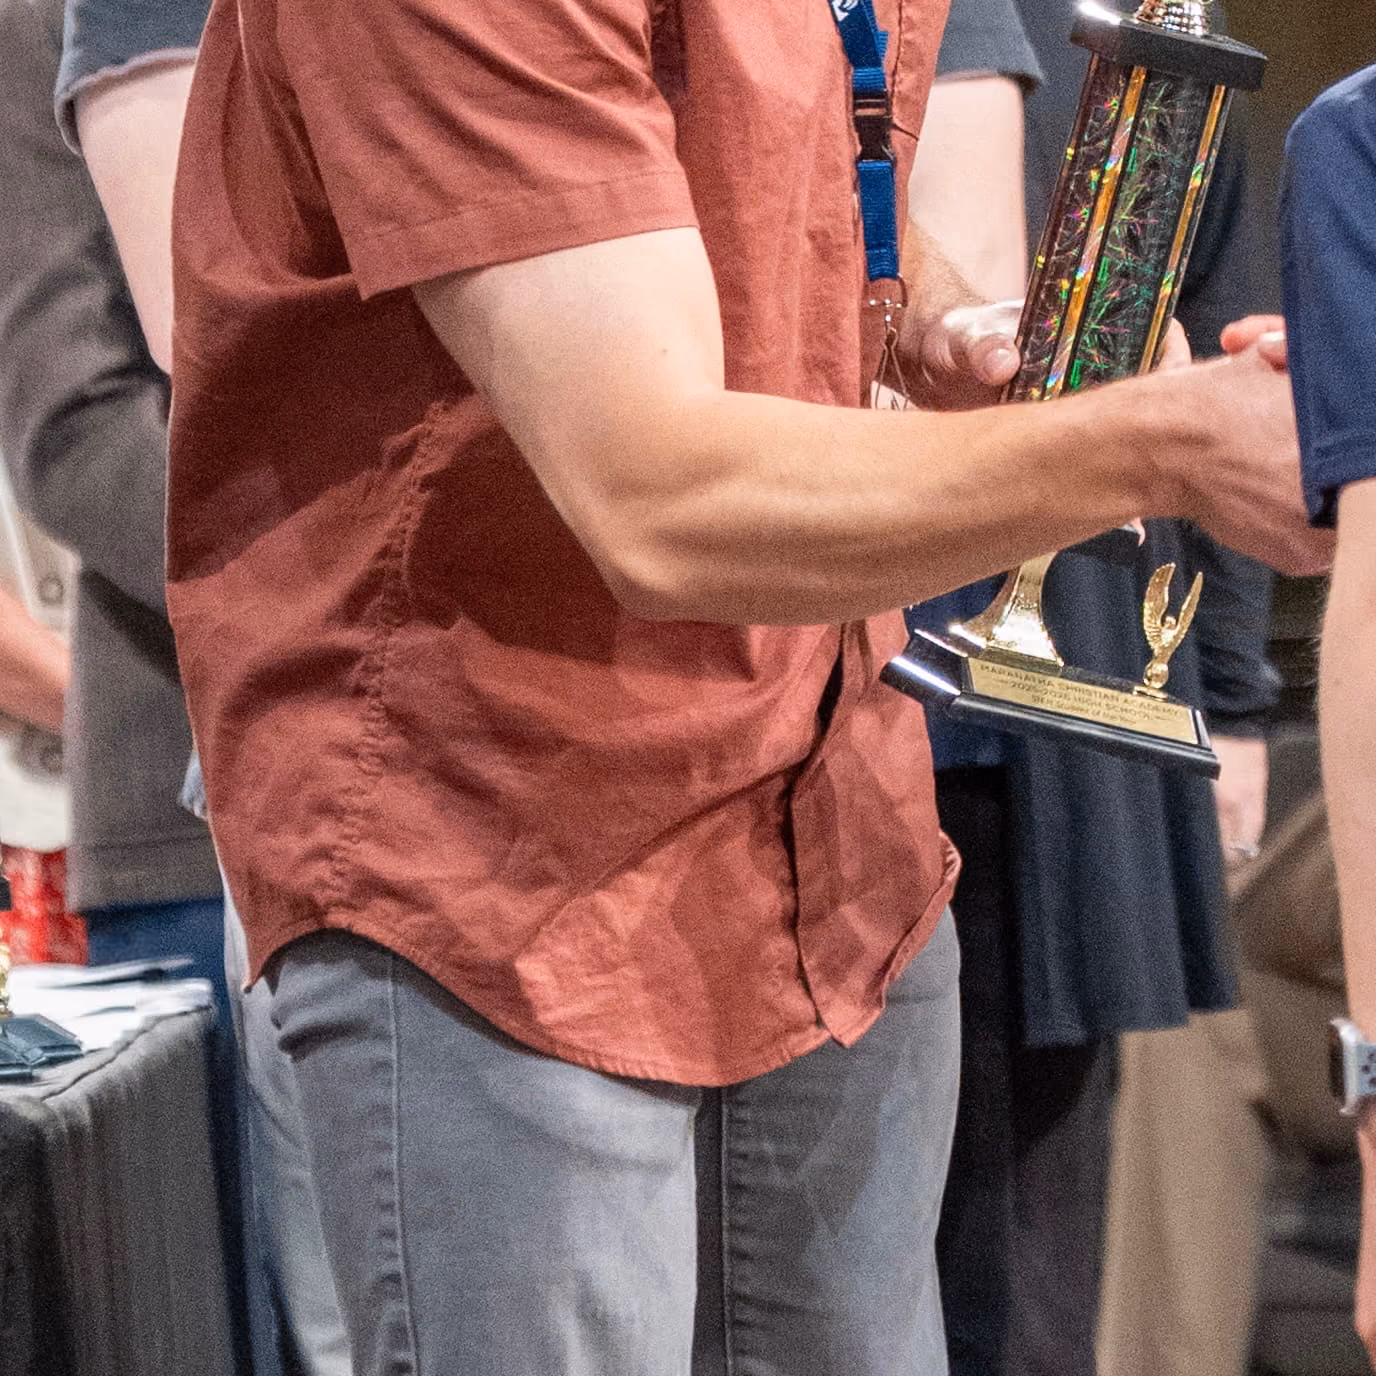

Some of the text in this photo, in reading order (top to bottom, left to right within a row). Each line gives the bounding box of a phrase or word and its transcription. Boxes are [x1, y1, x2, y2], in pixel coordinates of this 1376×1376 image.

[980, 664, 1179, 716] MARANATHA CHRISTIAN ACADEMY
[1074, 694, 1103, 708] HIGH
[1105, 702, 1151, 720] SCHOOL
